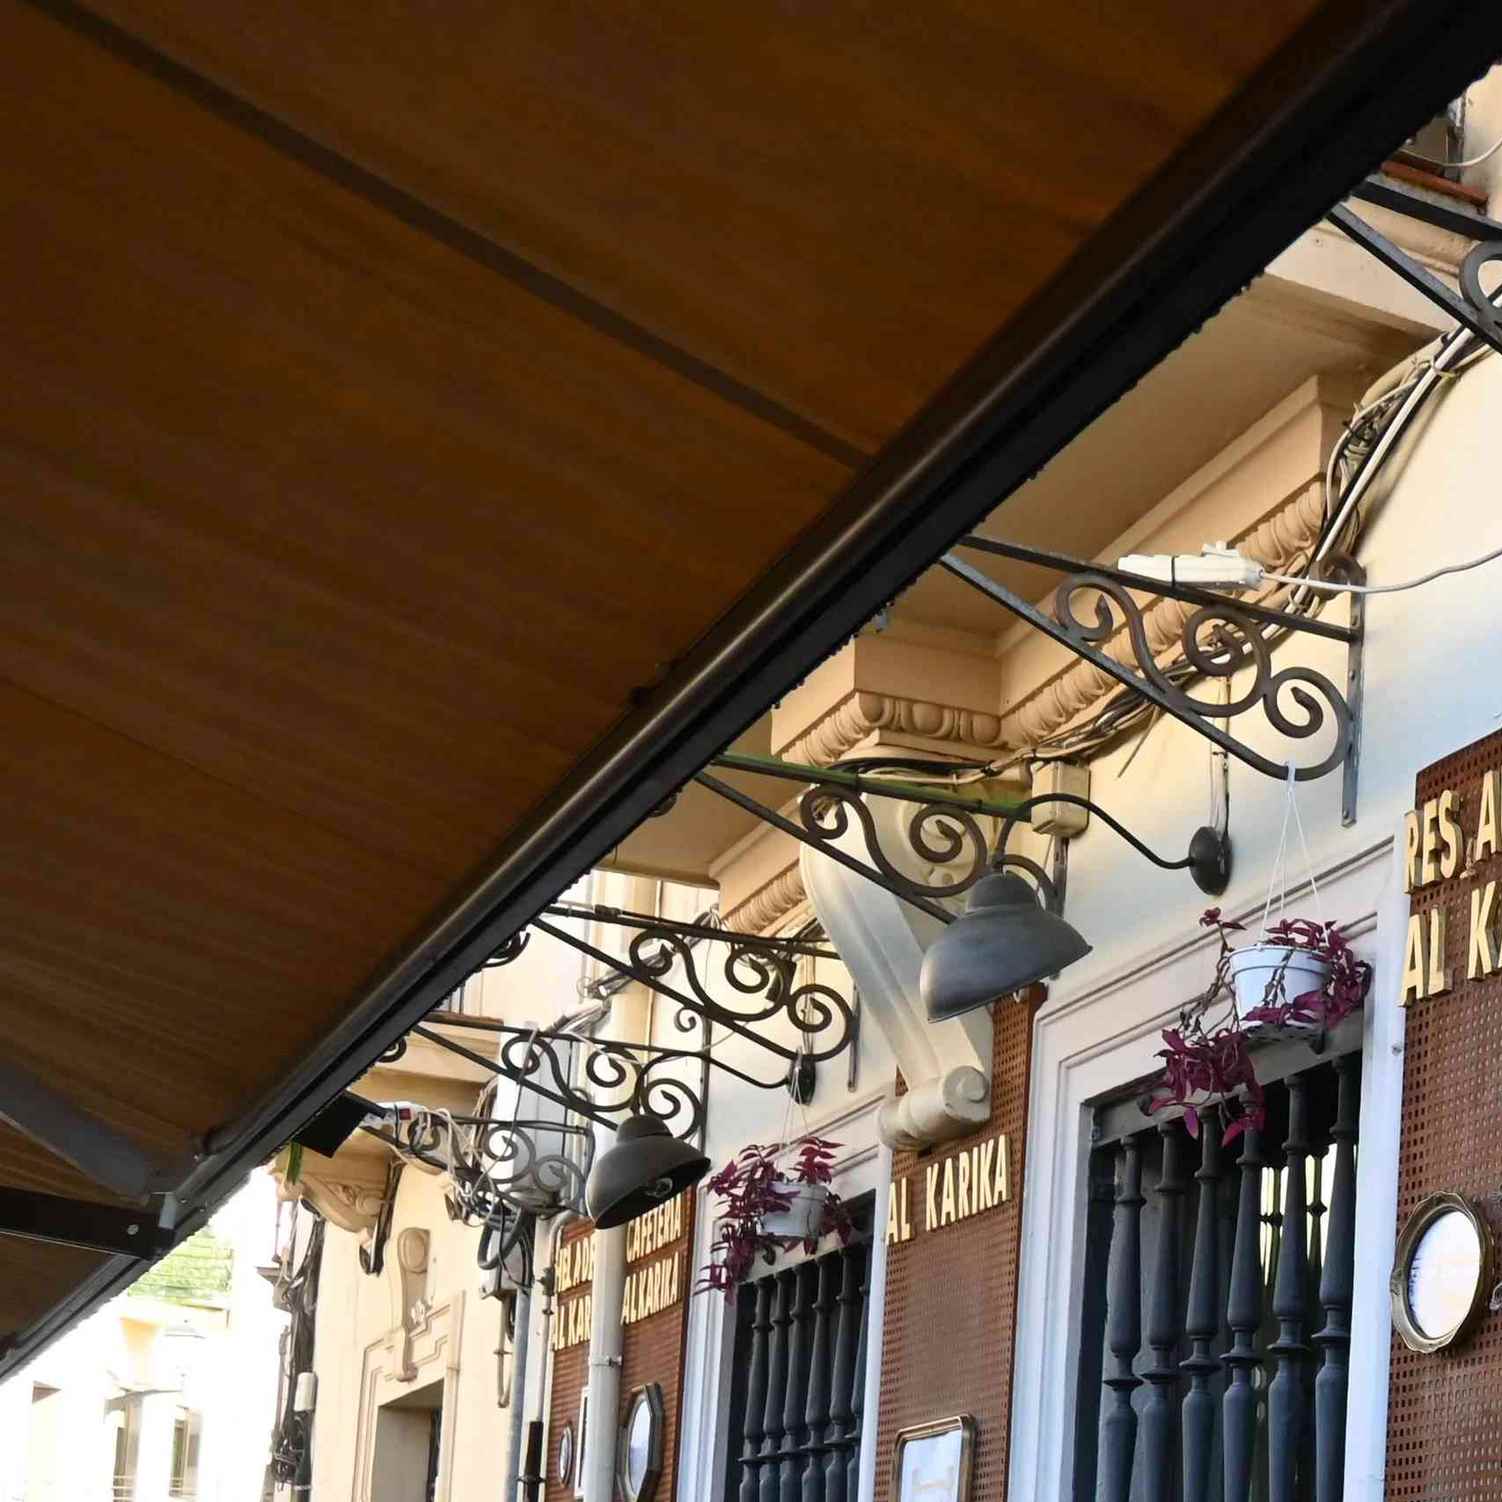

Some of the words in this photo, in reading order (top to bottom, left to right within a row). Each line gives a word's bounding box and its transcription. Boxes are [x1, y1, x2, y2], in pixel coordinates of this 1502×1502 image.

[1398, 906, 1453, 1008] AL
[885, 1176, 912, 1246] AL
[926, 1134, 1010, 1232] KARIKA
[567, 1294, 592, 1347] KAR
[620, 1272, 637, 1326] AL
[638, 1250, 680, 1321] KARIKA
